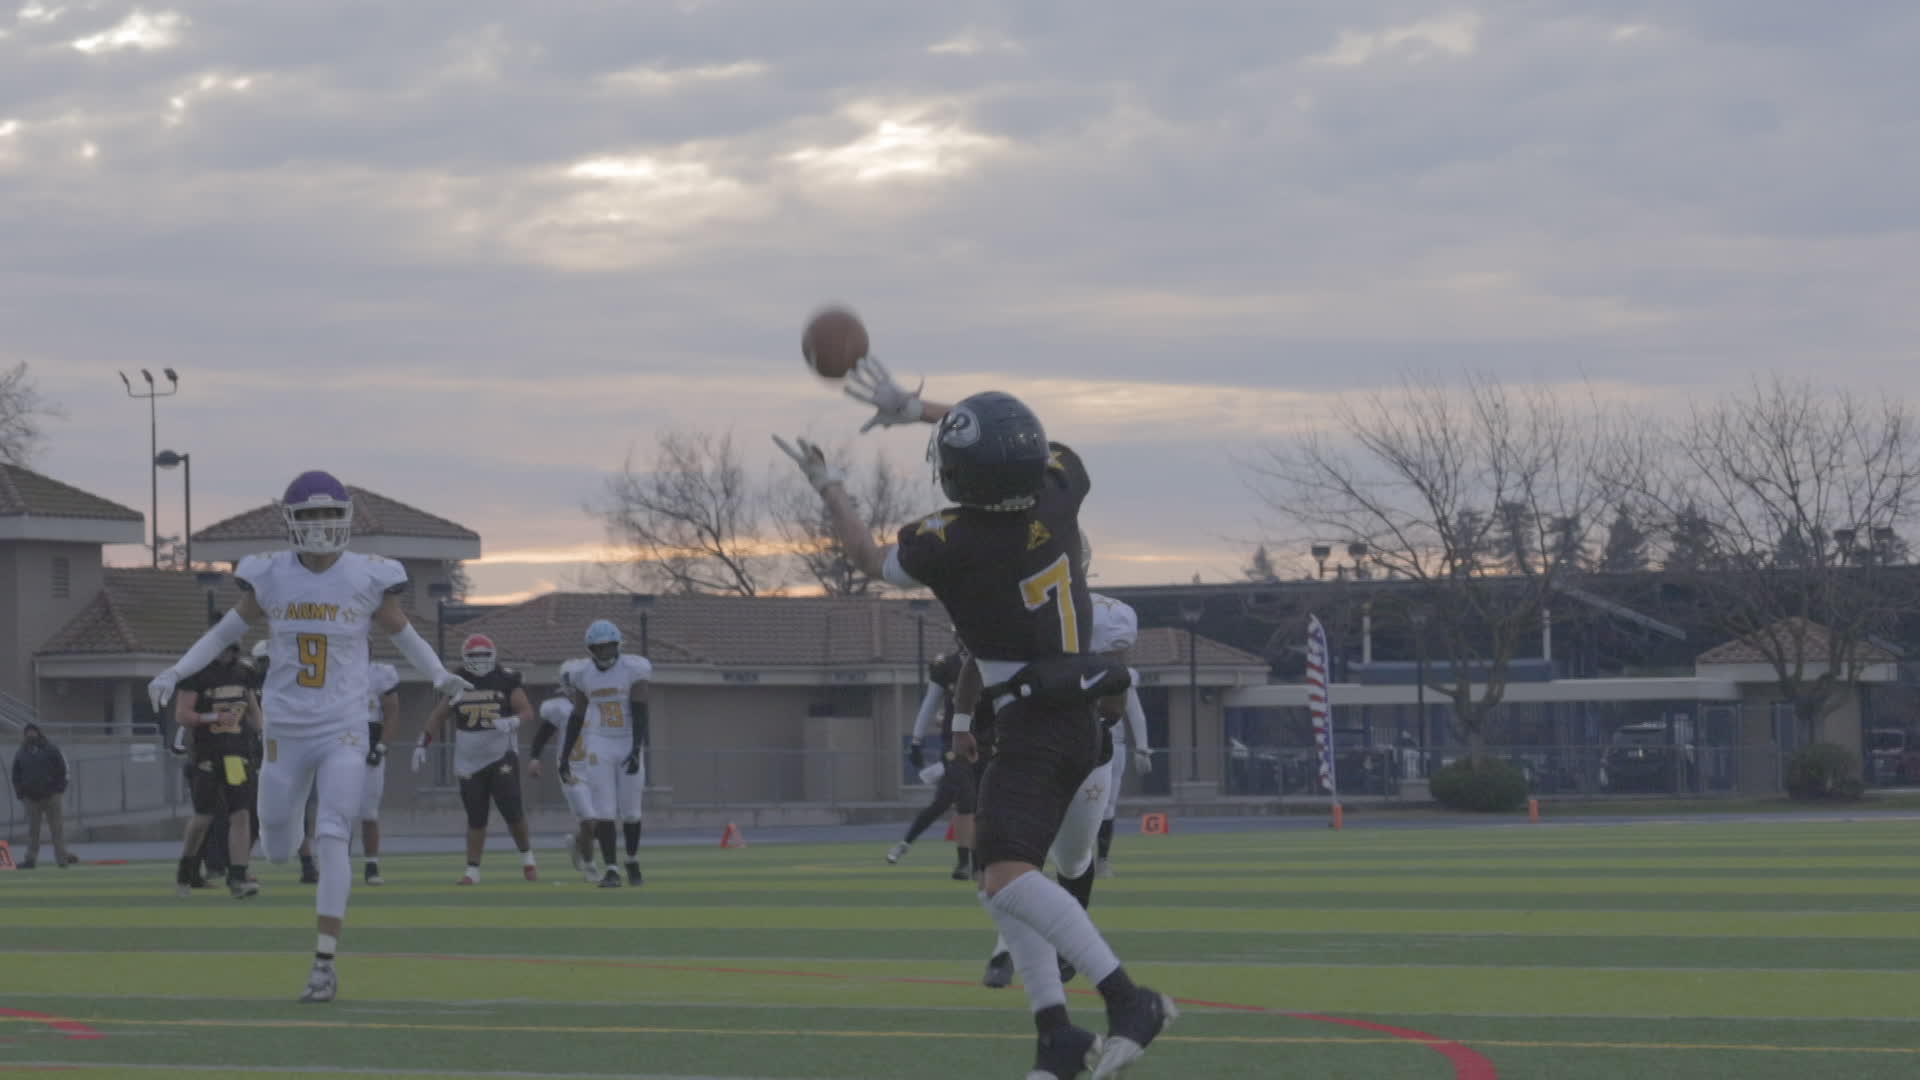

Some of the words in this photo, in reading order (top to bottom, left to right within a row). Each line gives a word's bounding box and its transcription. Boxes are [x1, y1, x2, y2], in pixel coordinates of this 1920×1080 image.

[287, 602, 345, 621] ARMY
[1019, 551, 1080, 654] 7
[296, 631, 328, 690] 9
[458, 703, 502, 729] 75
[1144, 816, 1160, 832] G
